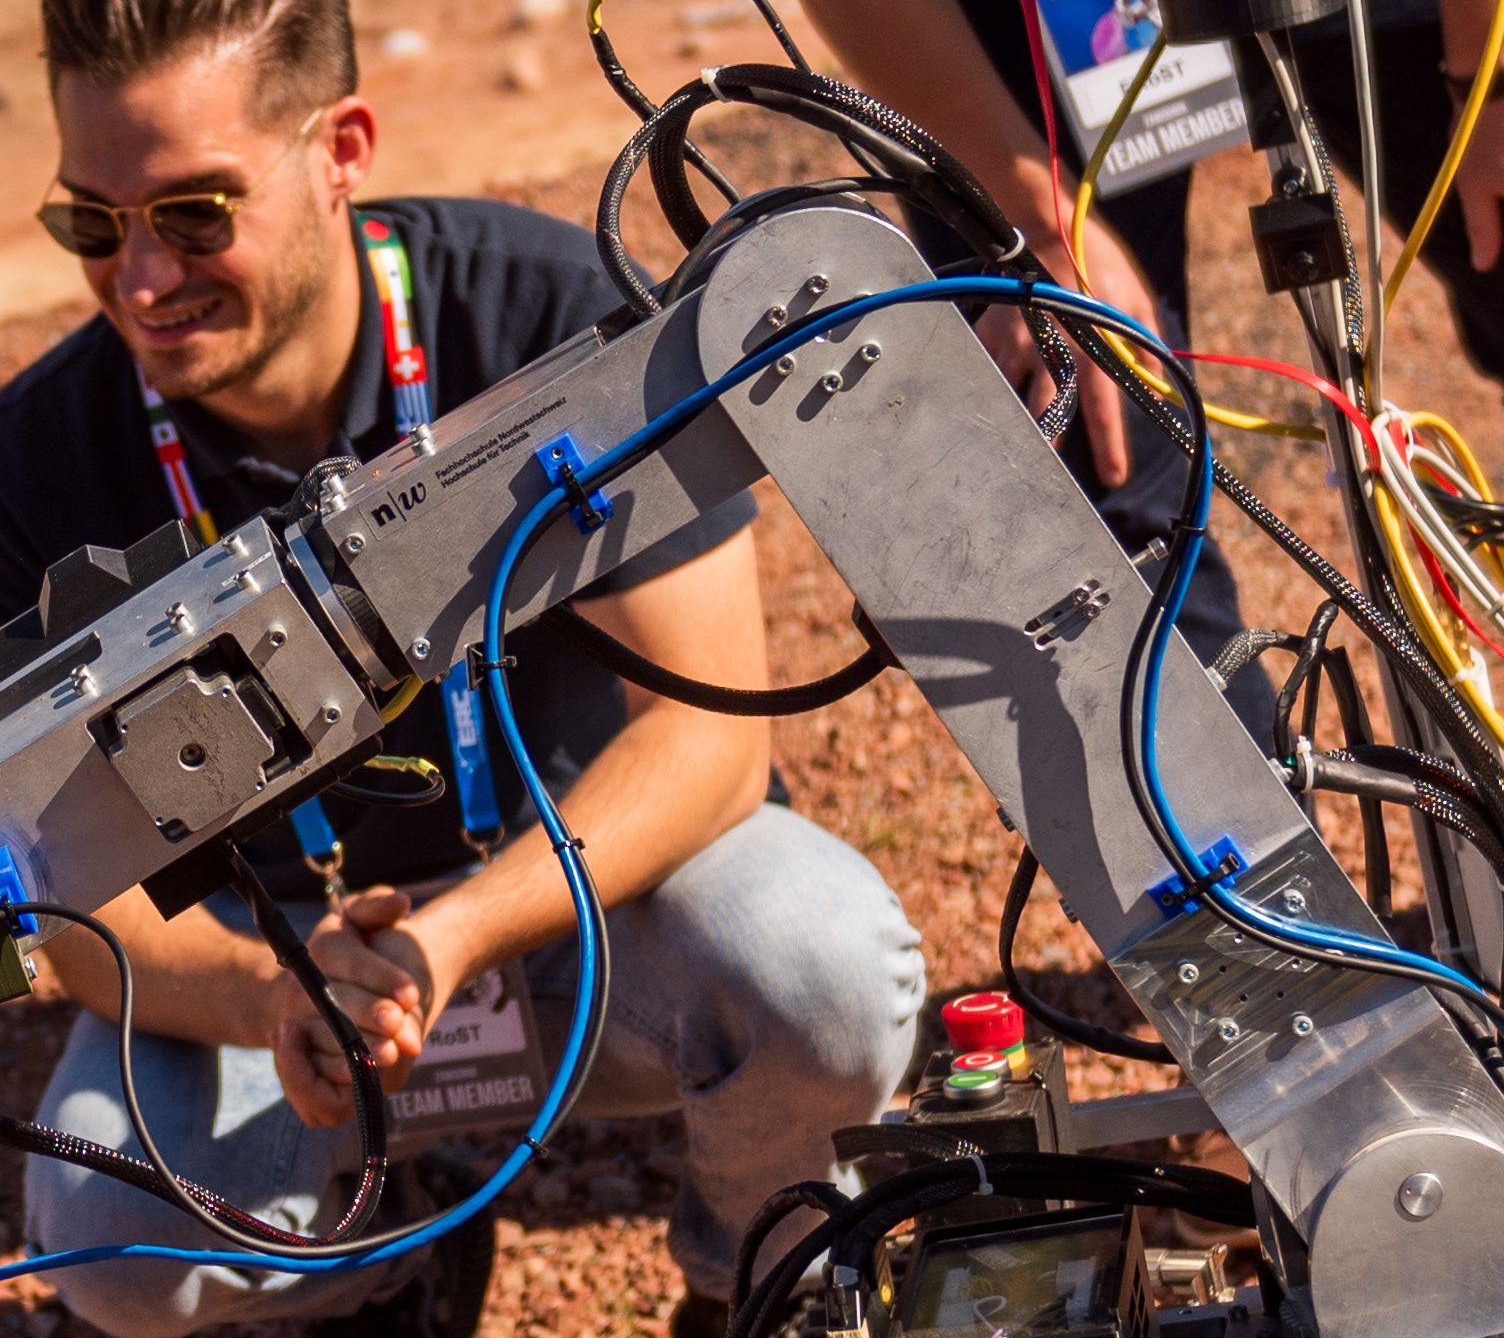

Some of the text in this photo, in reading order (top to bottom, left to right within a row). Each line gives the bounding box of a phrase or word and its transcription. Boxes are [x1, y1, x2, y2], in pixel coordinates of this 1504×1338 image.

[1106, 132, 1160, 176] TEAM
[1158, 96, 1248, 155] MEMBER
[434, 395, 568, 480] Fachhochschule Nordwestschweiz
[440, 429, 532, 489] Hochschule für Technik
[451, 688, 478, 748] ERC
[389, 1075, 536, 1119] TEAM MEMBER
